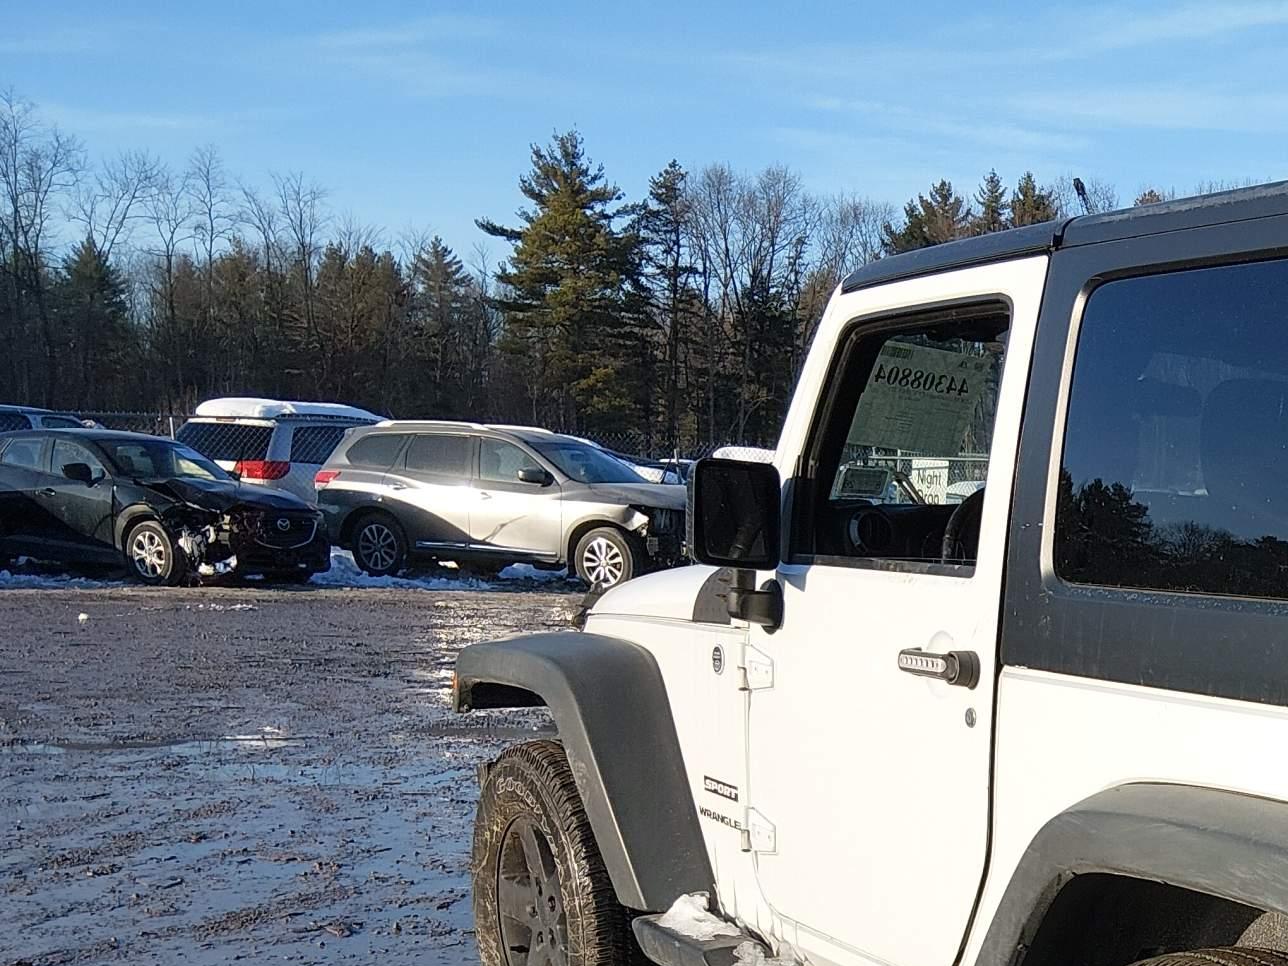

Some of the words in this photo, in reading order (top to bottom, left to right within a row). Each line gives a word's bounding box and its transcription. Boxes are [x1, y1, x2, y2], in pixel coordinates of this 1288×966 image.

[917, 469, 942, 488] Night
[704, 777, 738, 800] SPORT
[699, 805, 742, 831] WRANGLE
